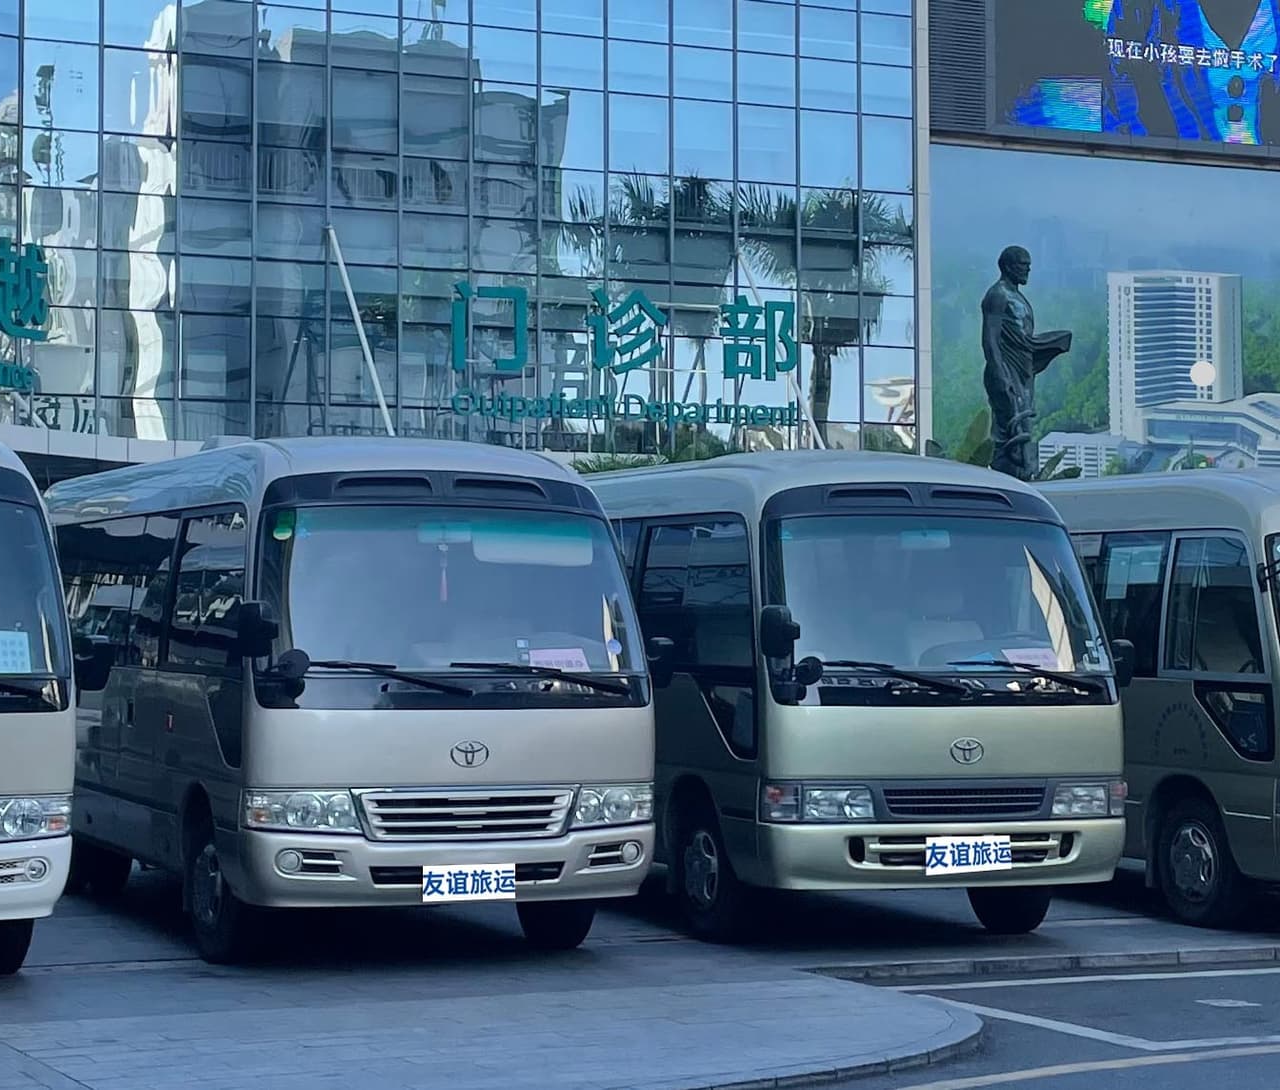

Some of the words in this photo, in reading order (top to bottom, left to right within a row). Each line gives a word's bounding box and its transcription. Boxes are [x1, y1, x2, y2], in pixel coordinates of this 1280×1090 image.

[1107, 38, 1279, 73] 现在小孩要去做手术了
[451, 280, 798, 381] 门诊部
[451, 388, 616, 423] Outpatient
[623, 394, 799, 427] Department
